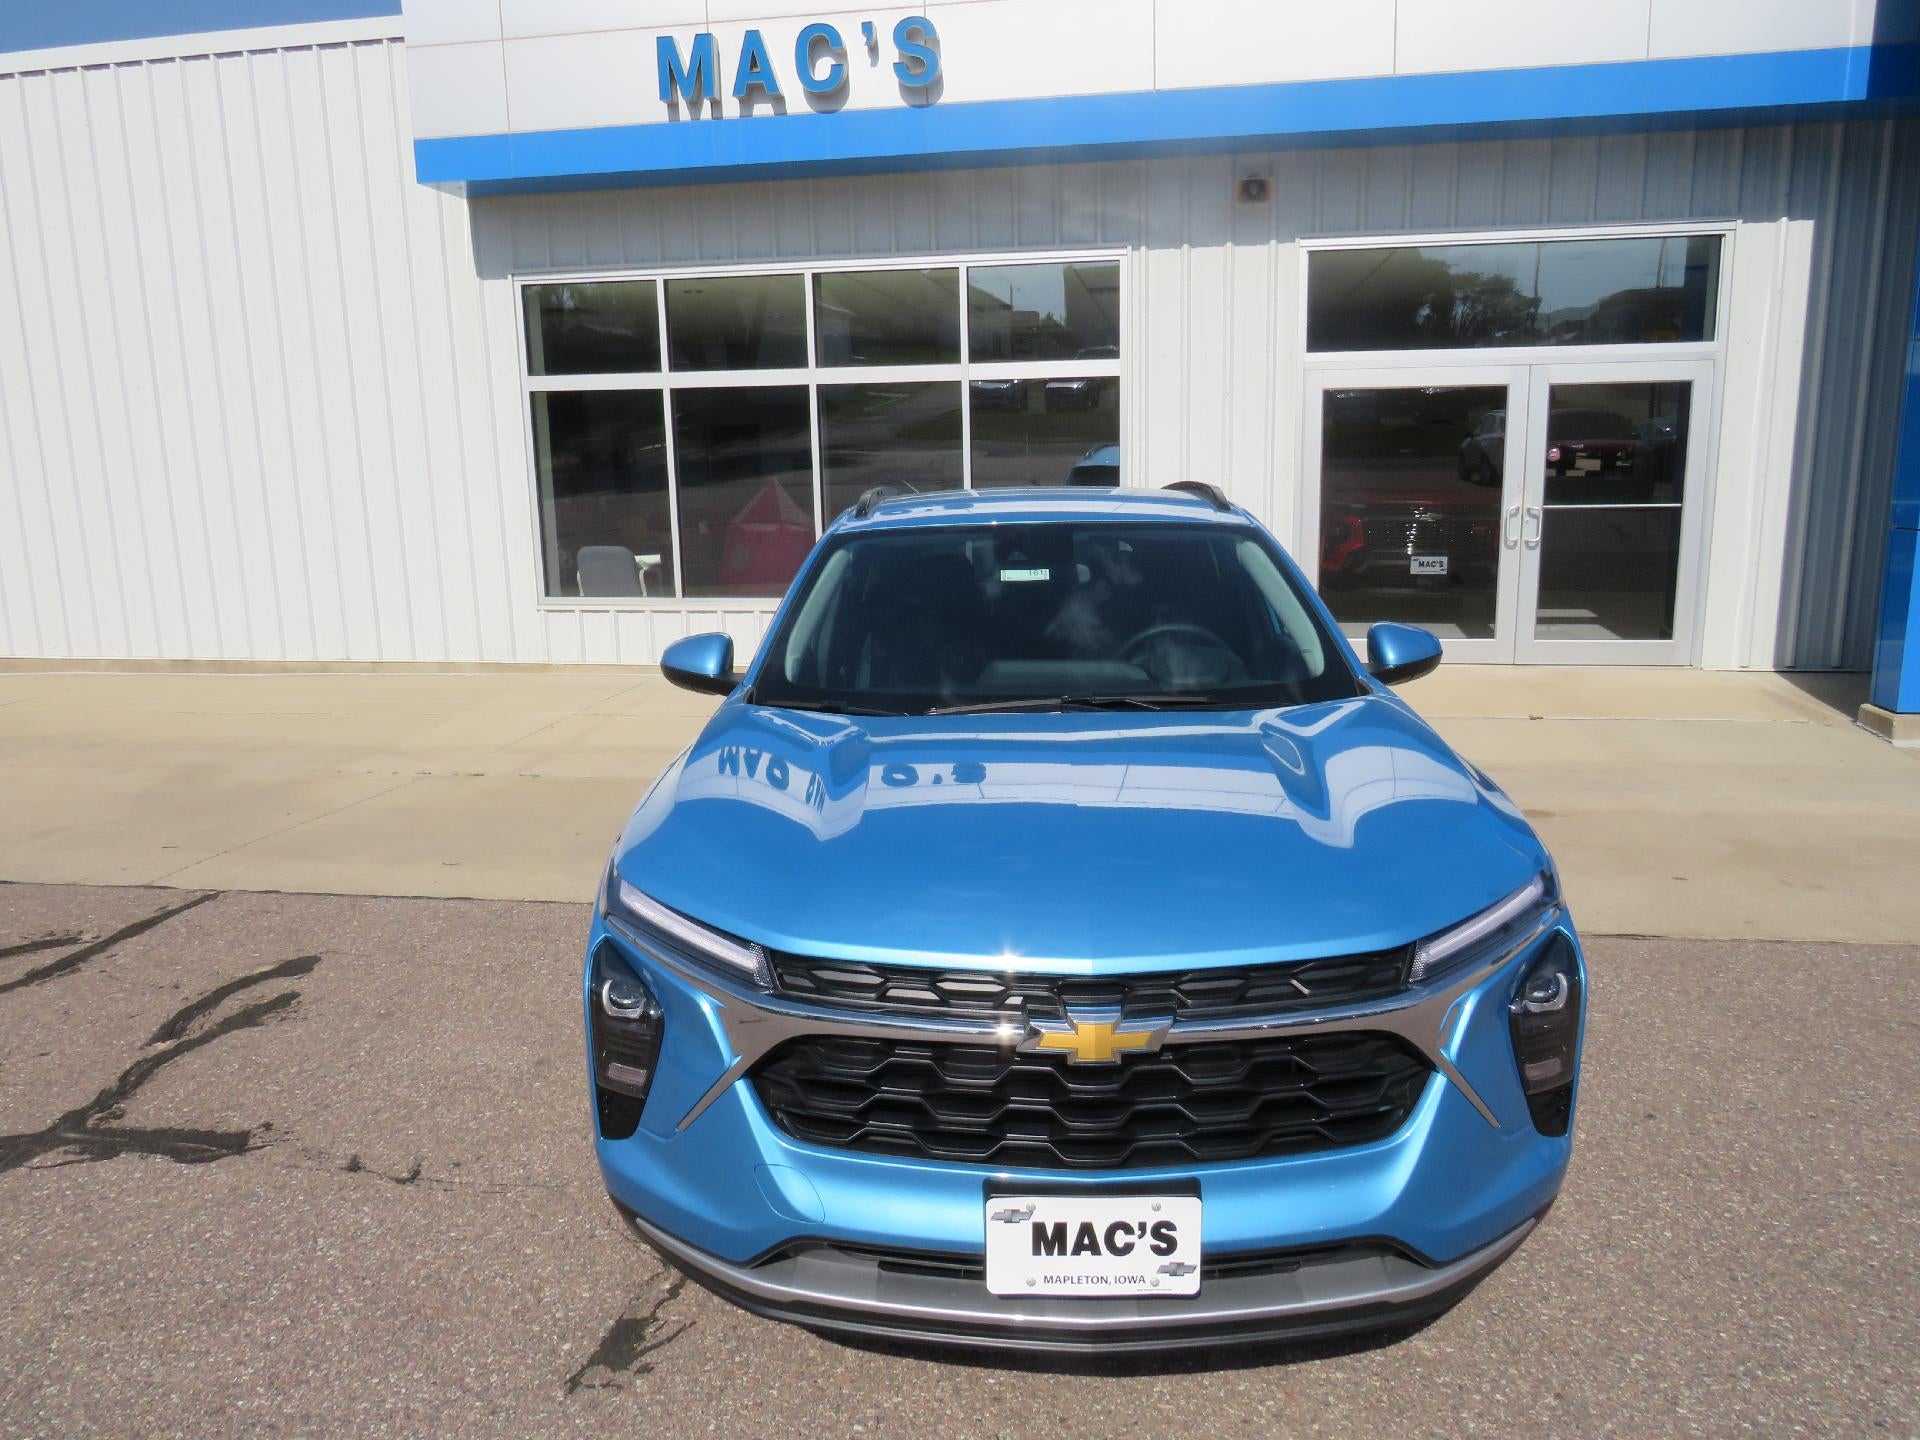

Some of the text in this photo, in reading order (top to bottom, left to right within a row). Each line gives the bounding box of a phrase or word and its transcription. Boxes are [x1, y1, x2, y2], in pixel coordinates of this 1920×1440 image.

[656, 16, 942, 106] MAC'S
[1418, 560, 1444, 568] MAC'S
[1031, 1220, 1178, 1257] MAC'S
[1043, 1274, 1146, 1286] MAPLETON, IOWA
